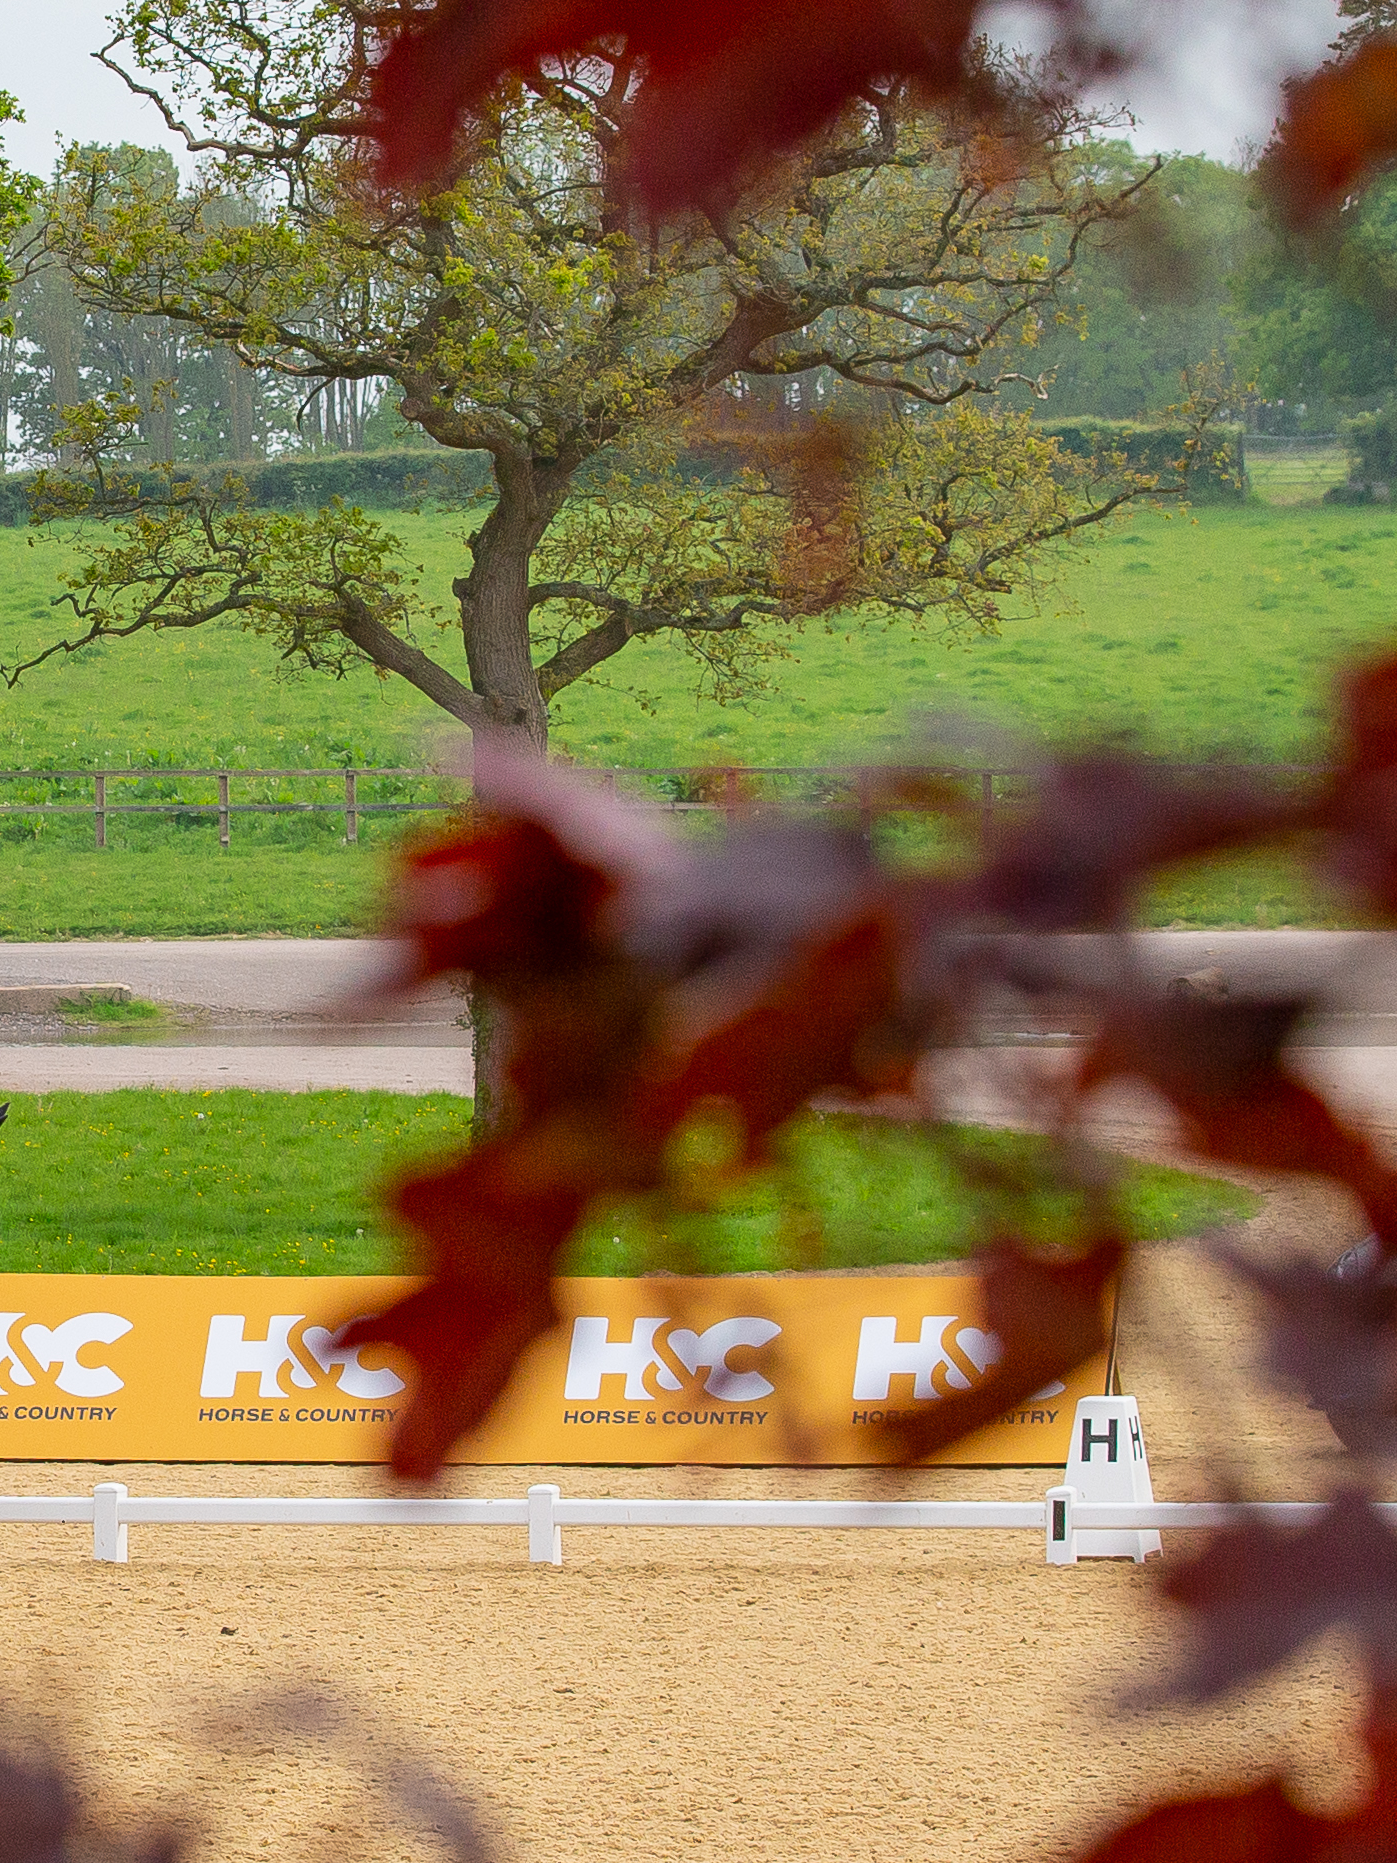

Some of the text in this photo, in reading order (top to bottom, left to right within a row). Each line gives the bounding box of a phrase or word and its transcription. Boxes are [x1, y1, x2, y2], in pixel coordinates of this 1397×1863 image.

[564, 1316, 782, 1402] H&C
[853, 1316, 1066, 1400] H&
[14, 1406, 117, 1420] COUNTRY
[199, 1408, 401, 1422] HORSE & COUNTRY
[563, 1410, 769, 1425] HORSE & COUNTRY
[1081, 1418, 1118, 1462] H
[1128, 1415, 1143, 1461] H
